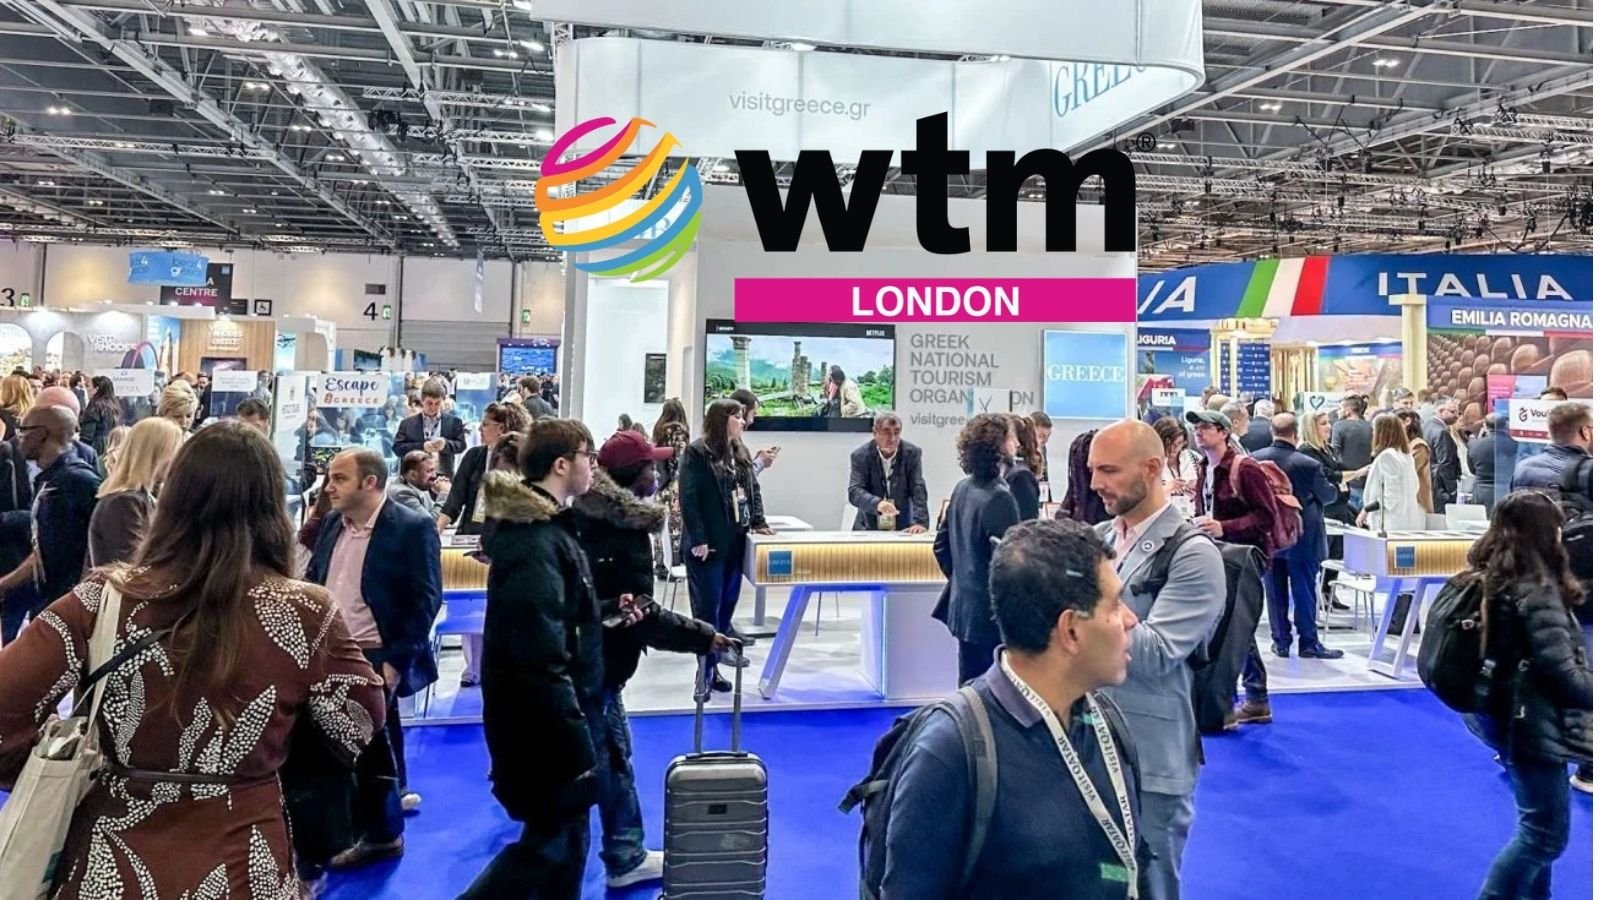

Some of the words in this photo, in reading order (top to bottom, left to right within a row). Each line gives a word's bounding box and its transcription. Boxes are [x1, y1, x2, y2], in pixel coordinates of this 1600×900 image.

[729, 91, 871, 120] visitgreece.gr
[175, 287, 218, 297] CENTRE
[1378, 272, 1574, 301] ITALIA
[363, 302, 379, 321] 4
[1451, 309, 1507, 326] EMILIA
[1510, 311, 1593, 329] ROMAGNA
[910, 333, 970, 349] GREEK
[910, 352, 999, 368] NATIONAL
[910, 370, 992, 386] TOURISM
[1047, 364, 1125, 382] GREECE
[325, 377, 380, 396] Escape
